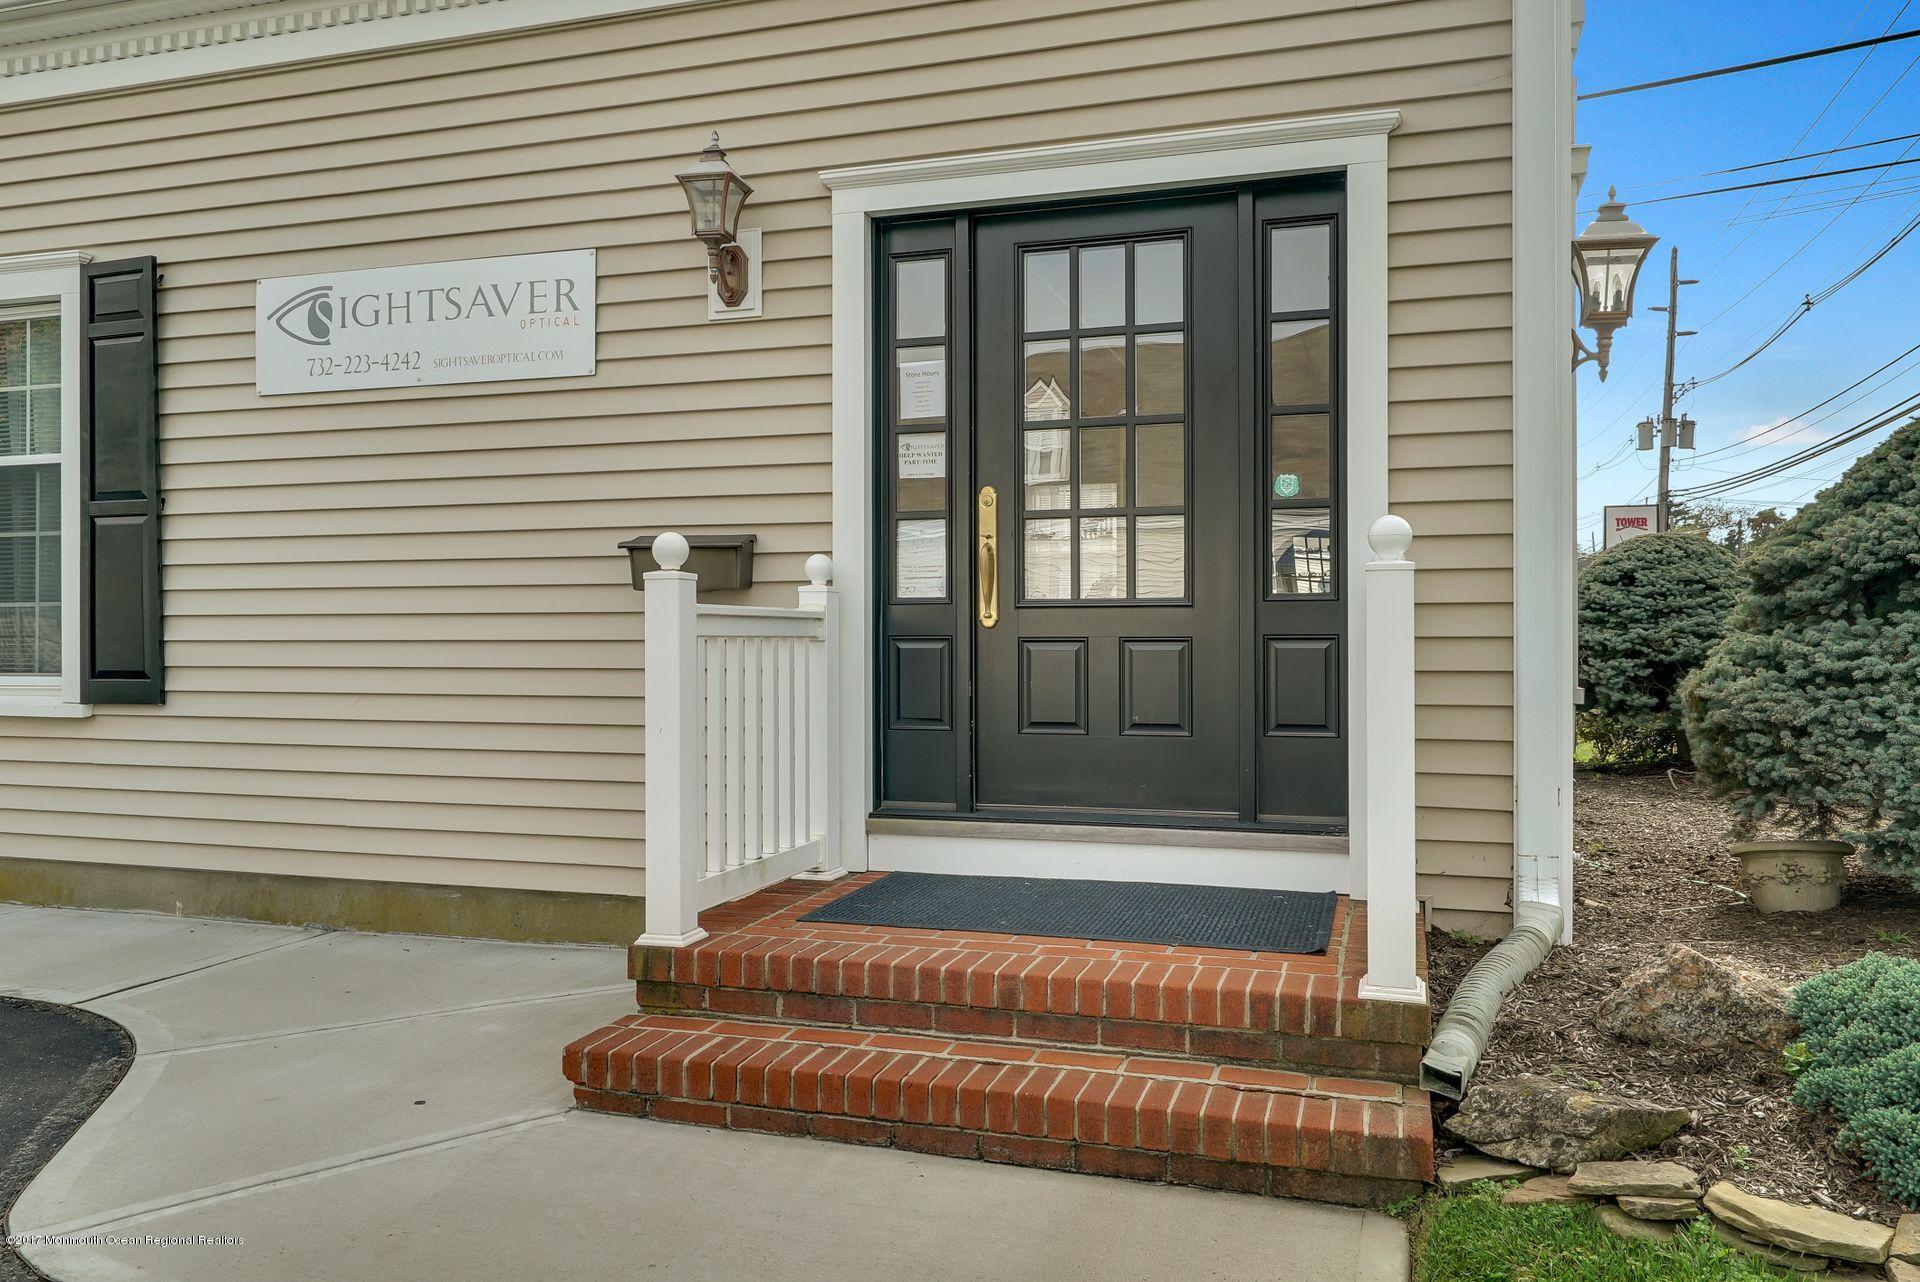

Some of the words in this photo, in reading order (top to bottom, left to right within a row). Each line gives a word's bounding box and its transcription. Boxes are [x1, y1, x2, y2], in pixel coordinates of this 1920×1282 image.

[519, 317, 580, 330] OPTICAL
[306, 350, 422, 377] 732-223-4242
[1615, 517, 1648, 527] TOWER
